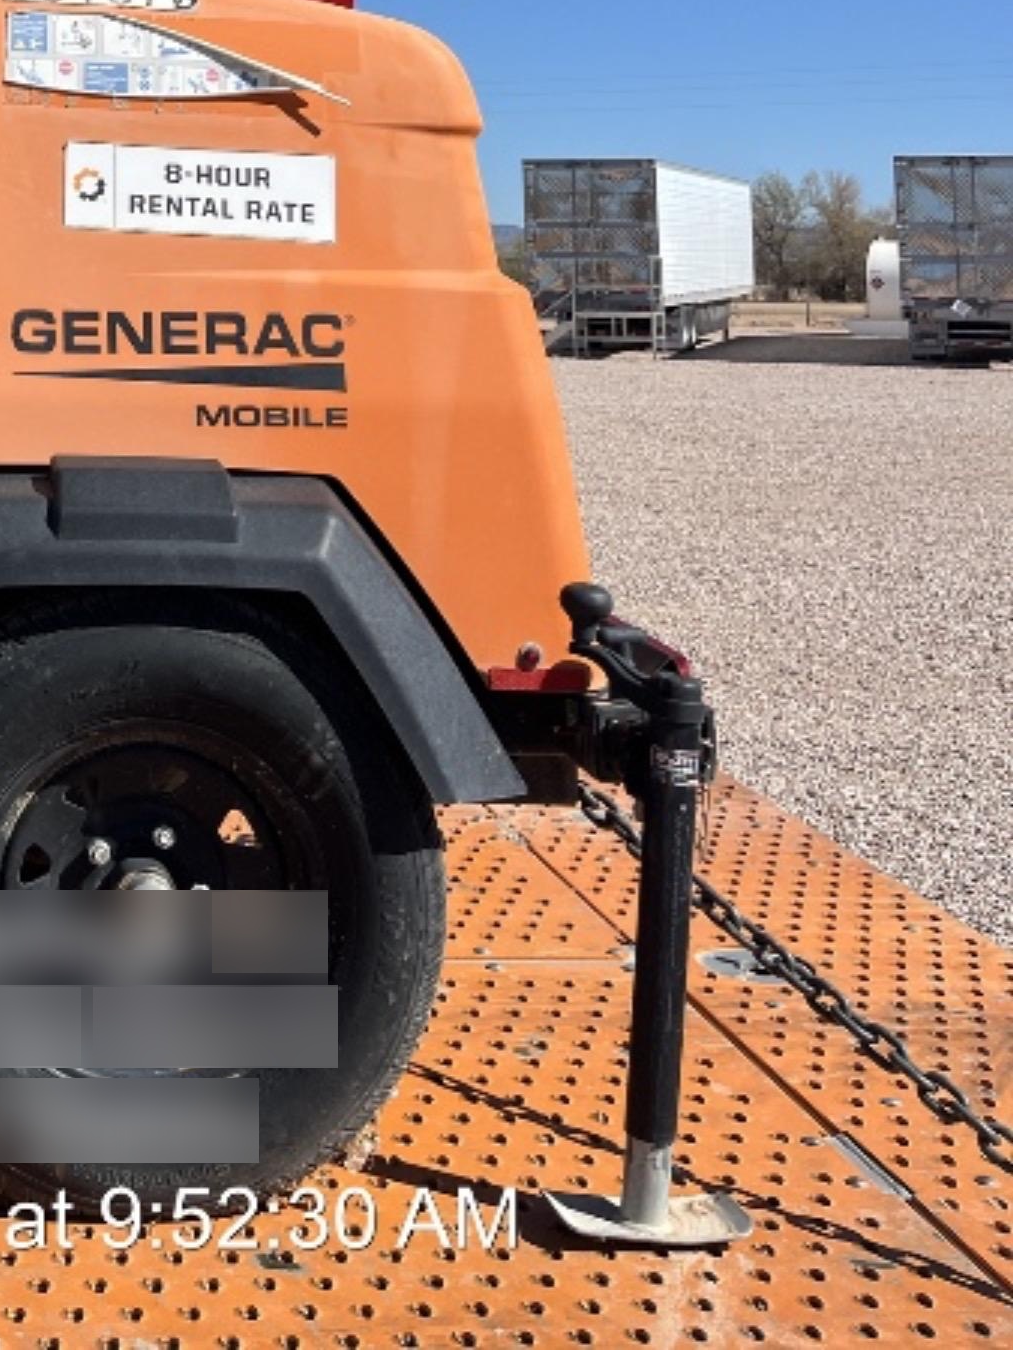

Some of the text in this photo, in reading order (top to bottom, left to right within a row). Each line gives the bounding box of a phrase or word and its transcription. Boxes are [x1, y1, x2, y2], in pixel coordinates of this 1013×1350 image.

[164, 163, 271, 189] 8-HOUR
[129, 193, 316, 225] RENTAL RATE
[10, 308, 345, 358] GENERAC
[195, 404, 349, 429] MOBILE
